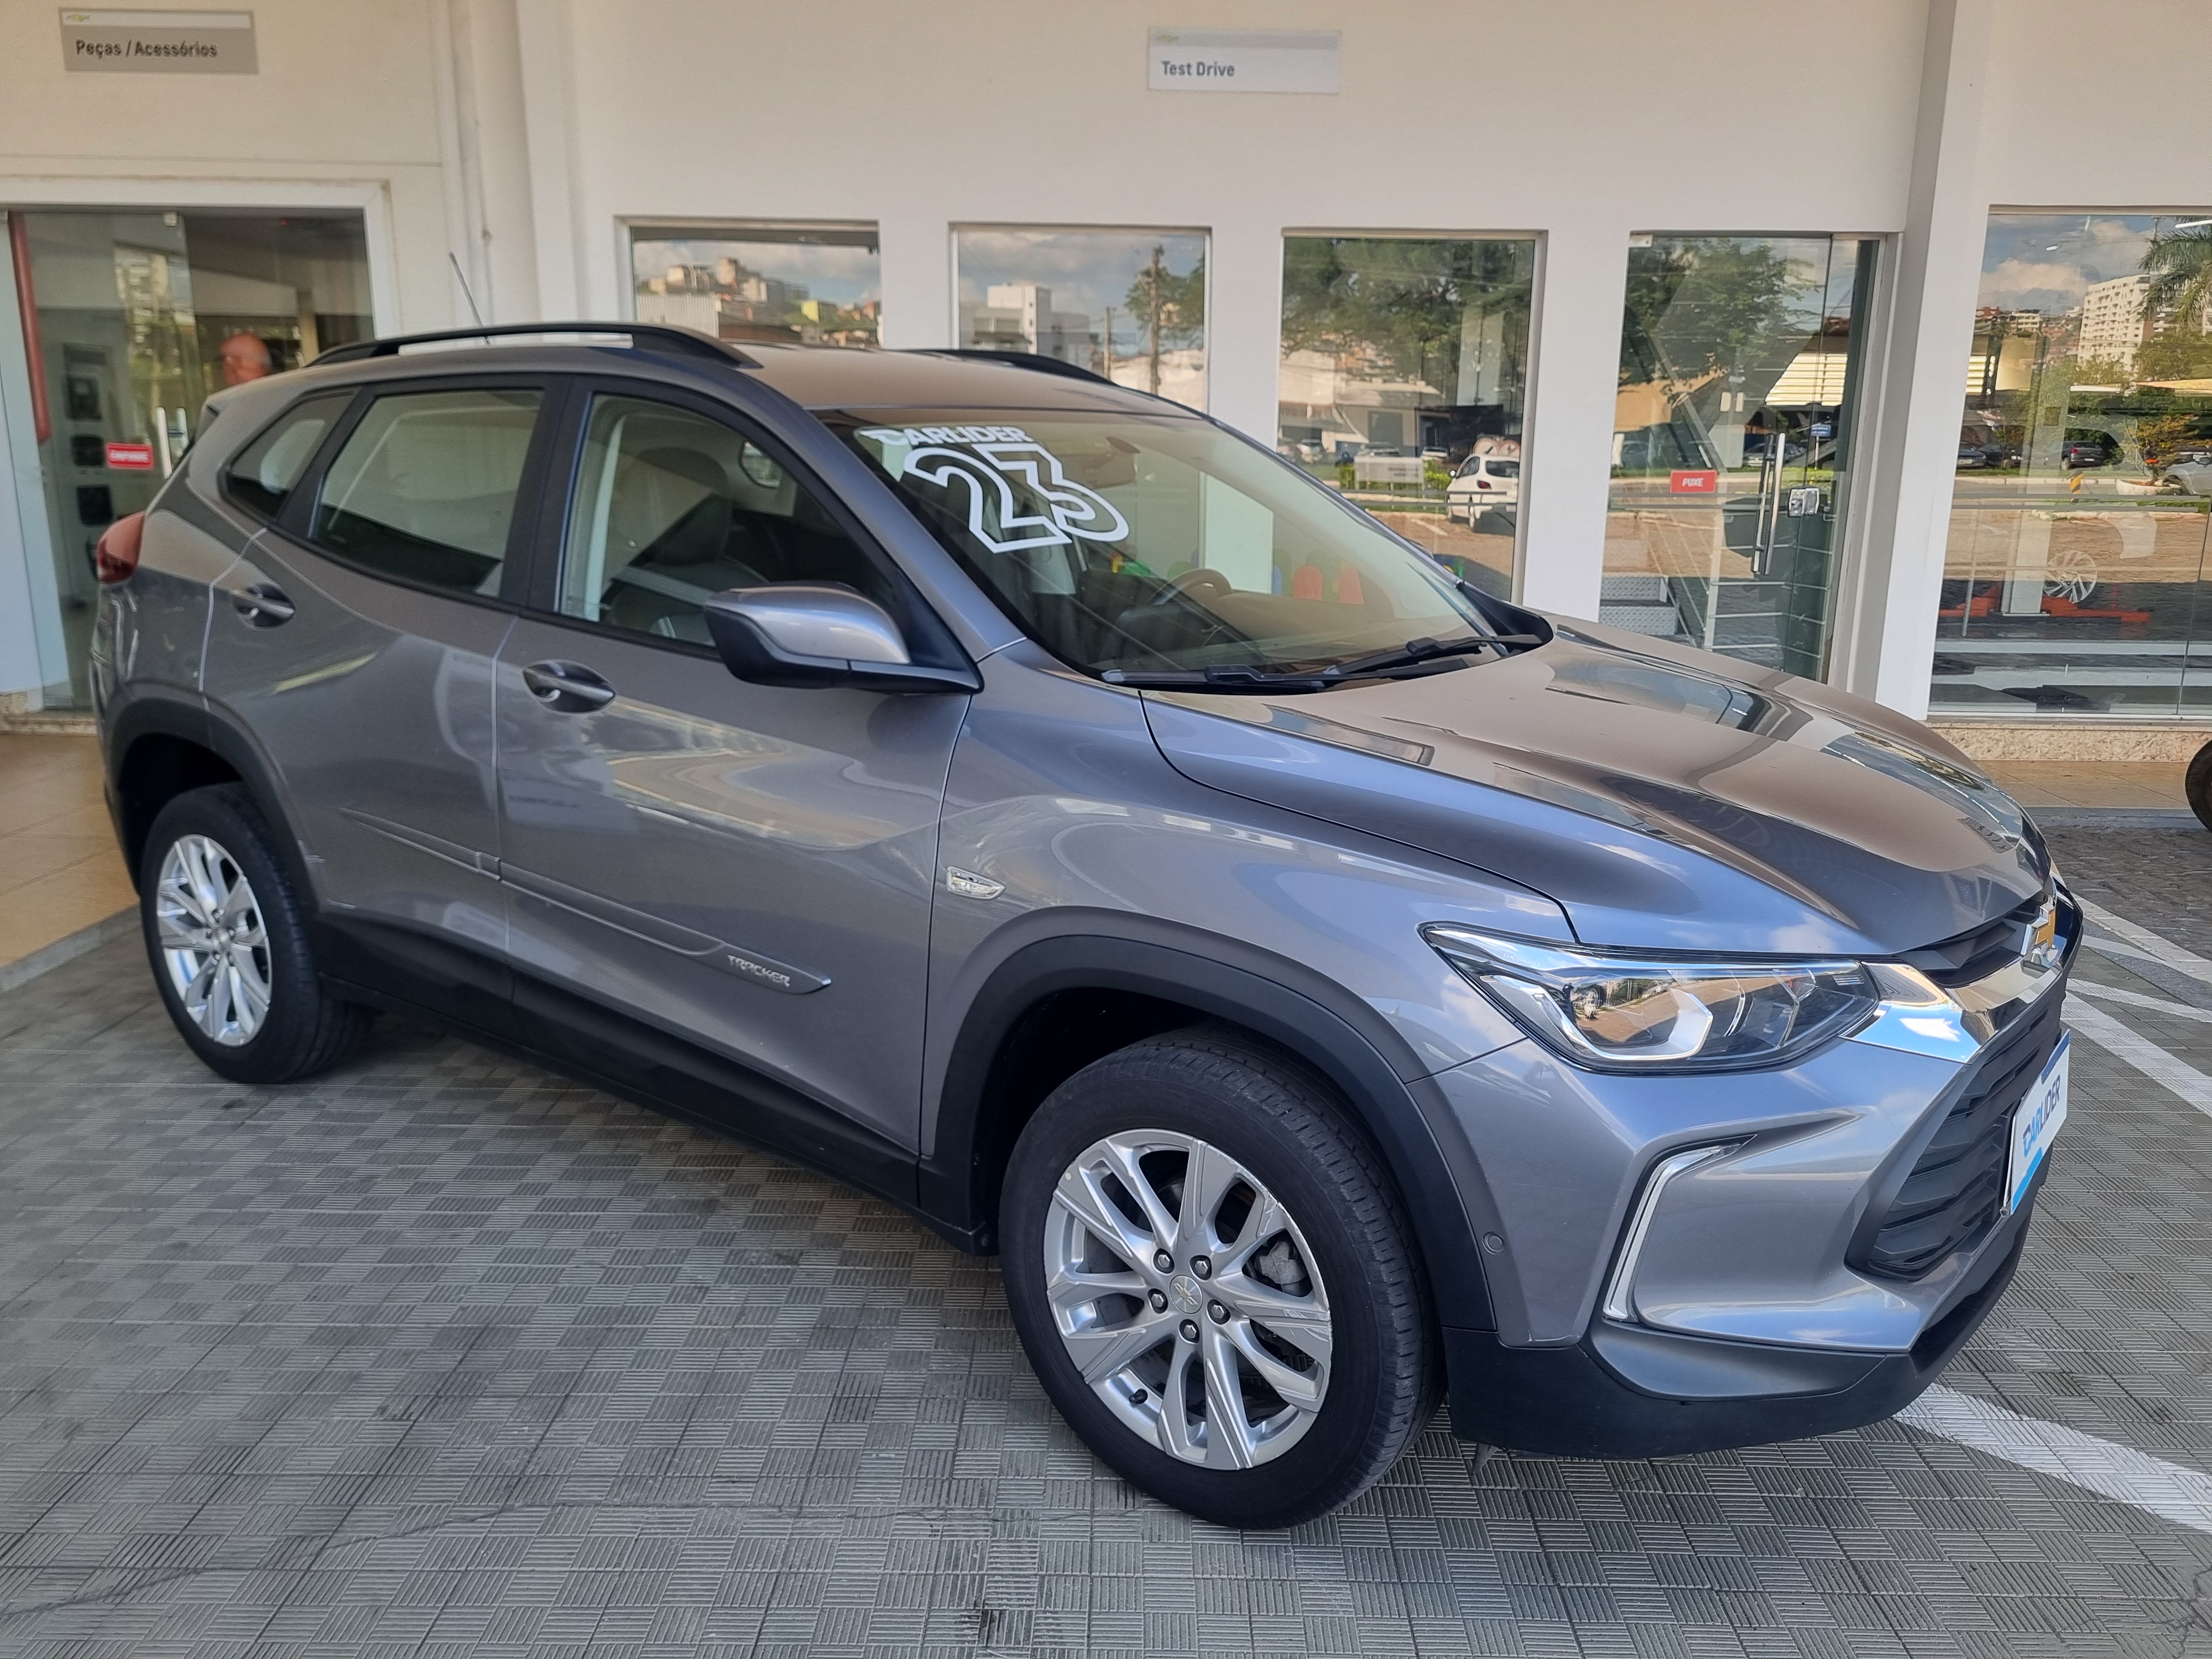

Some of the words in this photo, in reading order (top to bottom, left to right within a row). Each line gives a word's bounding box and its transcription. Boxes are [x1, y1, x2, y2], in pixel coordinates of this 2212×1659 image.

[76, 39, 122, 60] Peças
[125, 39, 132, 58] /
[134, 40, 218, 58] Acessórios
[1162, 60, 1192, 76] Test
[1196, 61, 1236, 77] Drive
[1682, 477, 1704, 487] PUXE
[904, 442, 1130, 554] 23
[727, 954, 790, 988] TRACKER
[2022, 1074, 2061, 1158] CARLIDER
